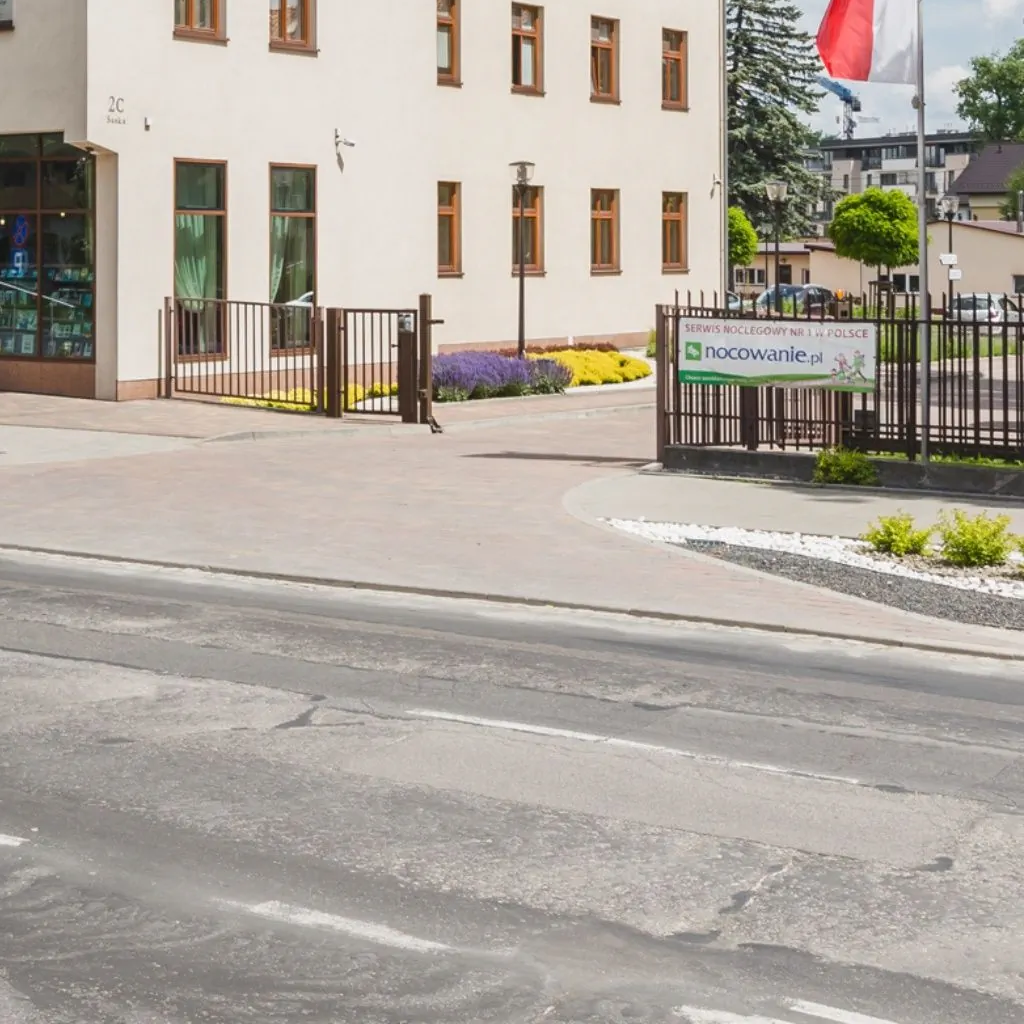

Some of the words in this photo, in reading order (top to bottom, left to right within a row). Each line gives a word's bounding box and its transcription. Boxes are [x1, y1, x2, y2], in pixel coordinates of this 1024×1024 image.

[685, 323, 721, 334] SERWIS
[723, 324, 788, 337] NOCLEGOWY
[790, 327, 805, 337] NR
[827, 328, 869, 339] POLSCE
[705, 345, 824, 366] nocowanie.pl
